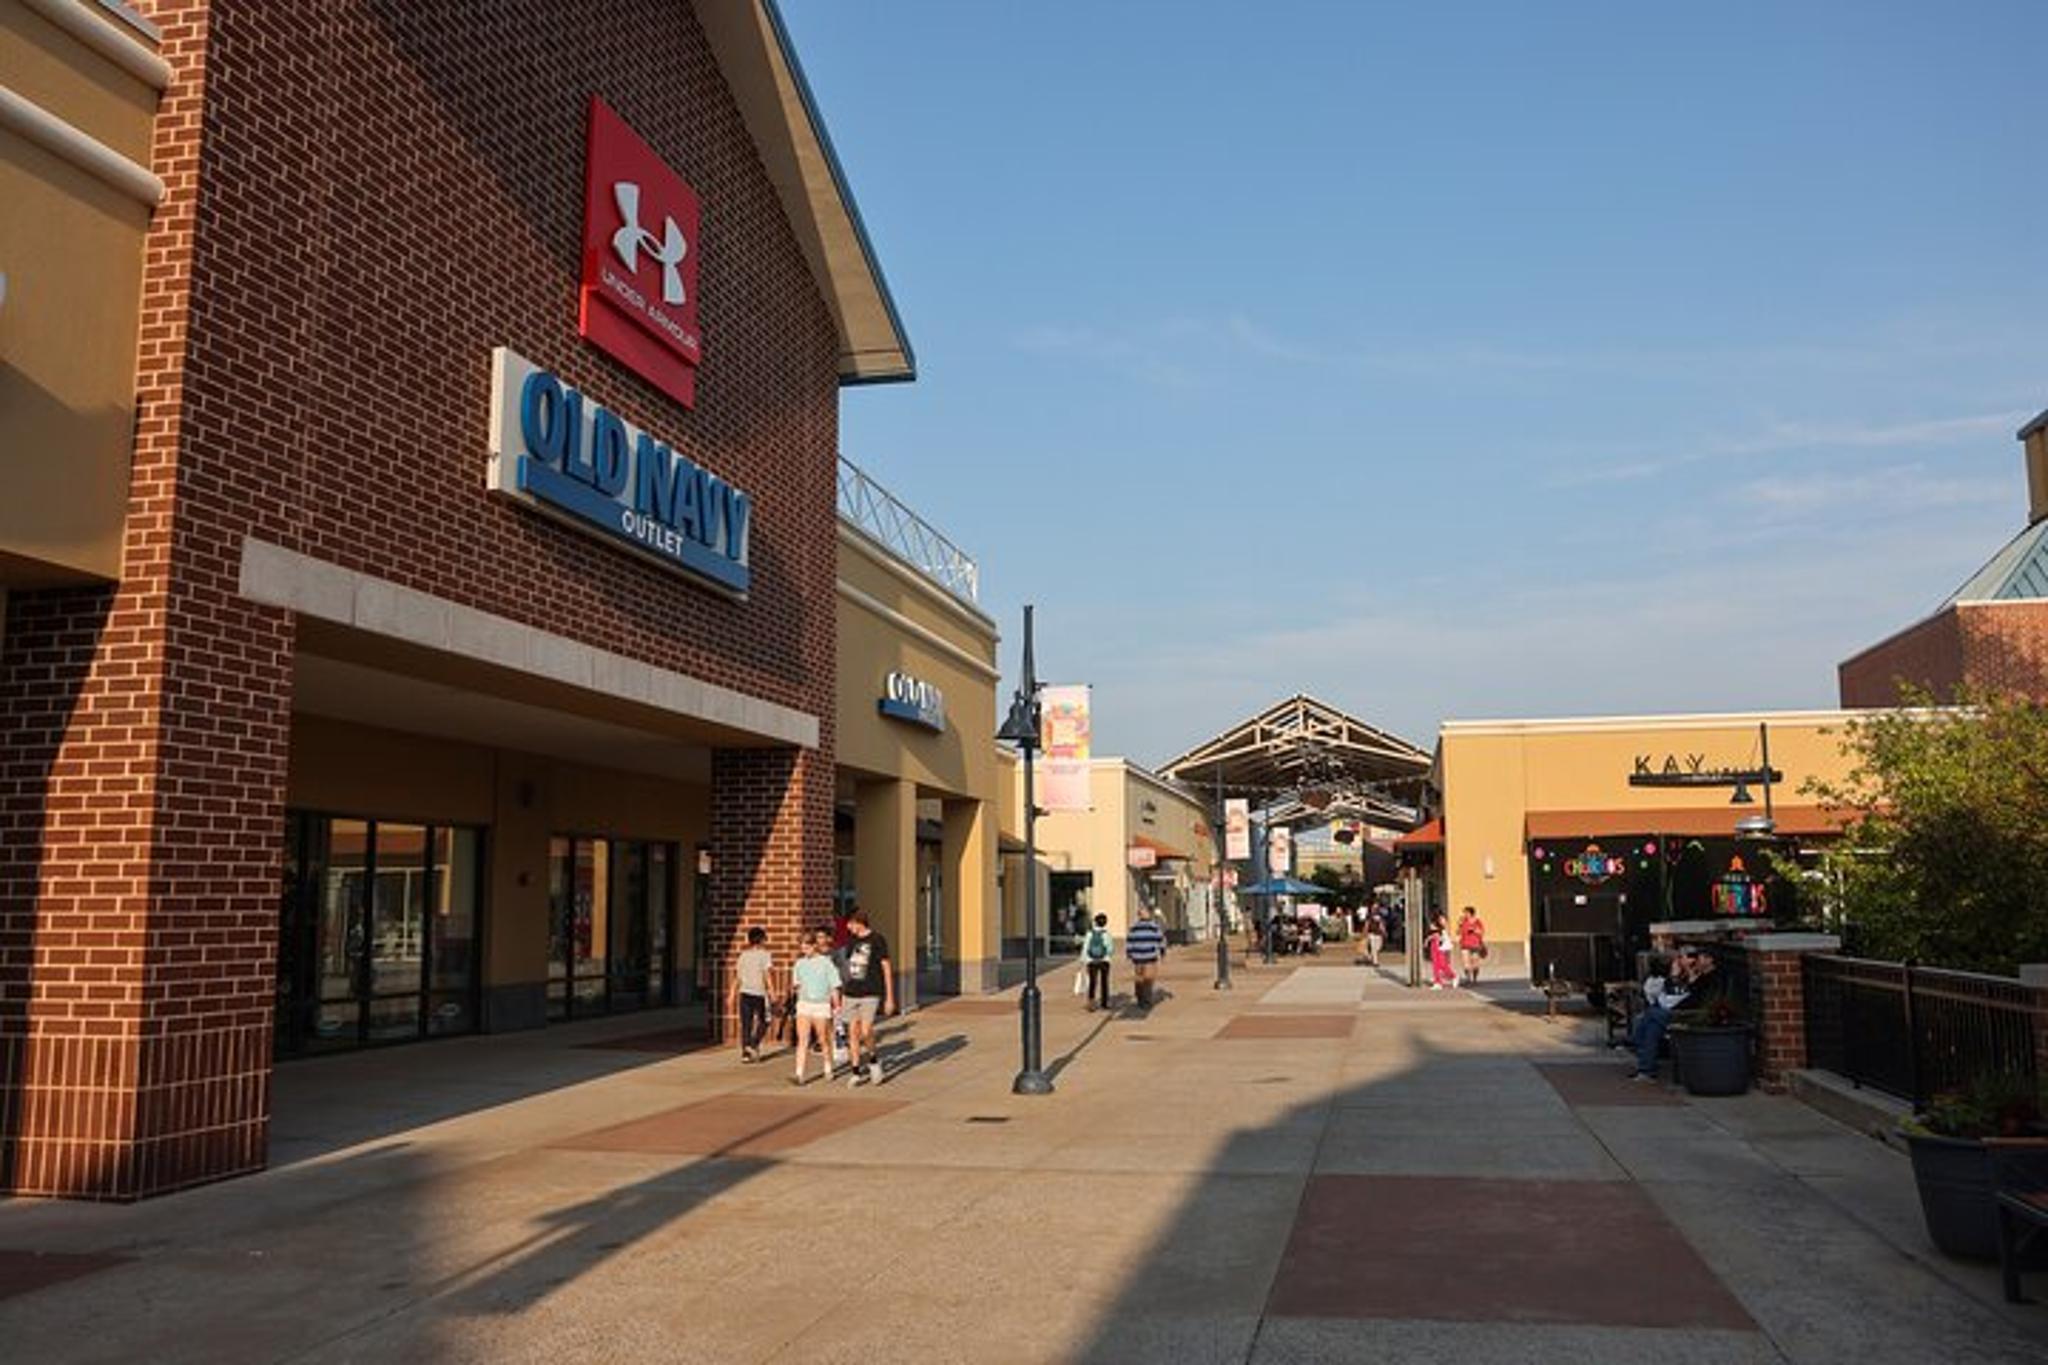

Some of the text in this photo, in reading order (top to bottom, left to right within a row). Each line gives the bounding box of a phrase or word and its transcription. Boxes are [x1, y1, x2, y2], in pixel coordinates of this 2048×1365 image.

[601, 266, 698, 351] UNDER ARMOUR
[520, 371, 749, 562] OLD NAVY
[621, 509, 684, 557] OUTLET
[1634, 753, 1705, 774] KAY
